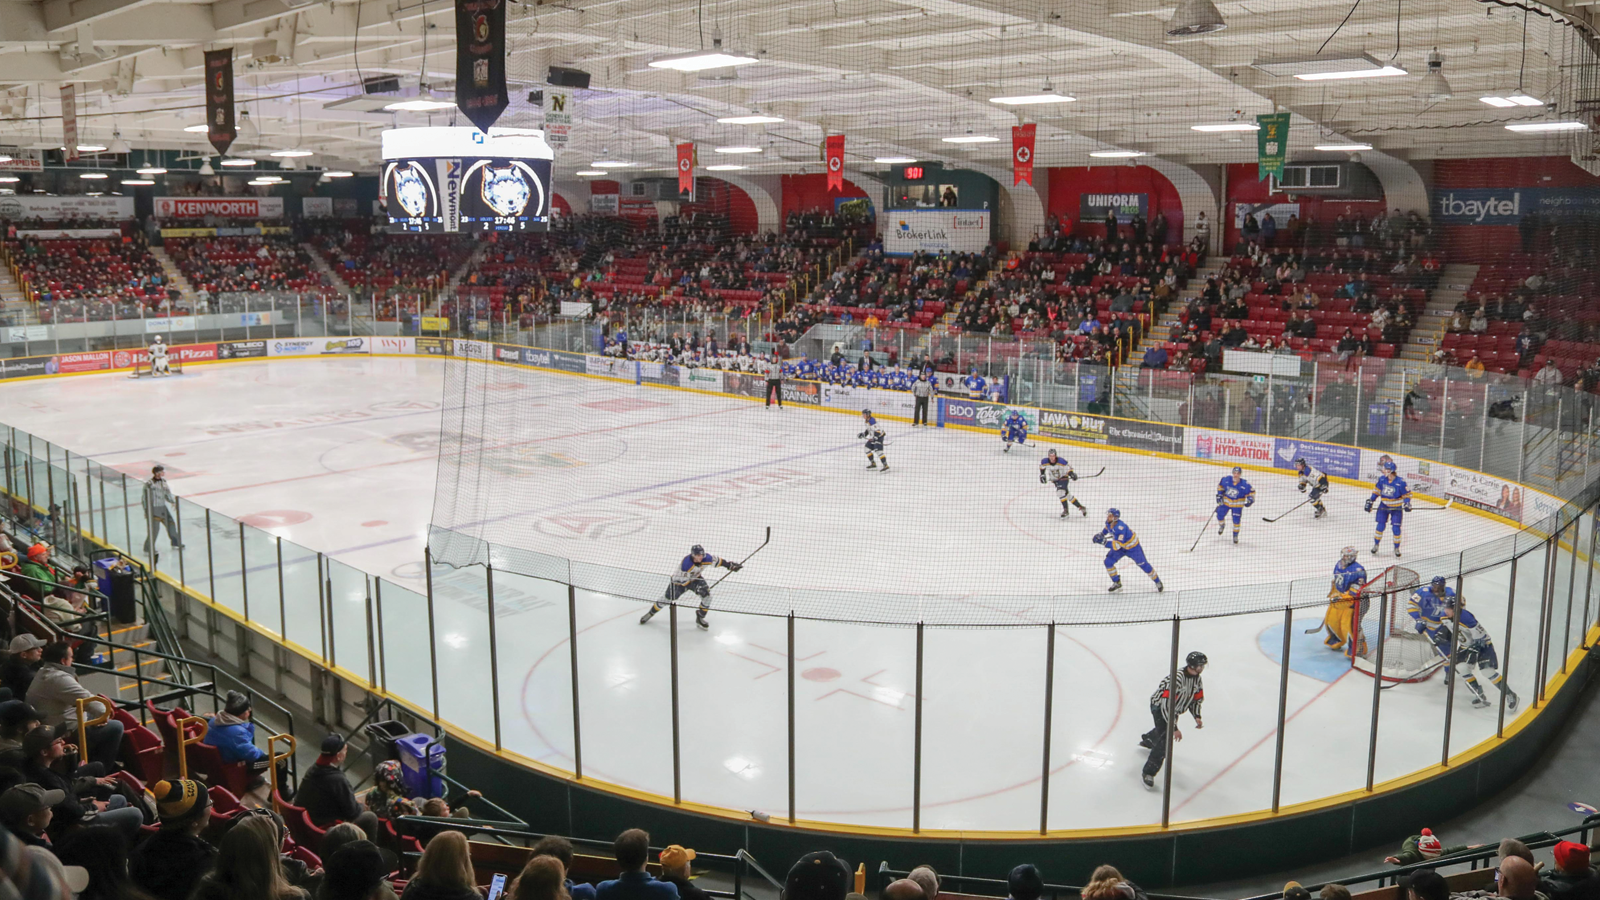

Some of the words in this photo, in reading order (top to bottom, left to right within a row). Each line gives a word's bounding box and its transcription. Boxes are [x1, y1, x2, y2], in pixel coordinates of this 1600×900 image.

[447, 161, 460, 232] Newmont
[1088, 194, 1139, 207] UNIFORM
[177, 201, 257, 215] KENWORTH
[1120, 206, 1139, 214] PROS
[1440, 192, 1520, 221] tbaytel
[483, 222, 489, 230] 2
[494, 217, 515, 225] 17:46
[520, 222, 525, 230] 5
[896, 229, 947, 239] BrokerLink
[61, 354, 82, 363] JASON
[82, 353, 109, 361] MALLON
[180, 349, 214, 359] Pizza
[525, 350, 550, 365] tbaytel
[781, 388, 819, 404] TRAINING
[950, 404, 974, 418] BDO
[1041, 412, 1069, 428] JAVA
[1109, 427, 1121, 436] The
[1122, 428, 1151, 440] Chronicle
[1156, 432, 1182, 444] Journal
[1214, 444, 1273, 461] HYDRATION.
[625, 467, 811, 511] DRIVEN
